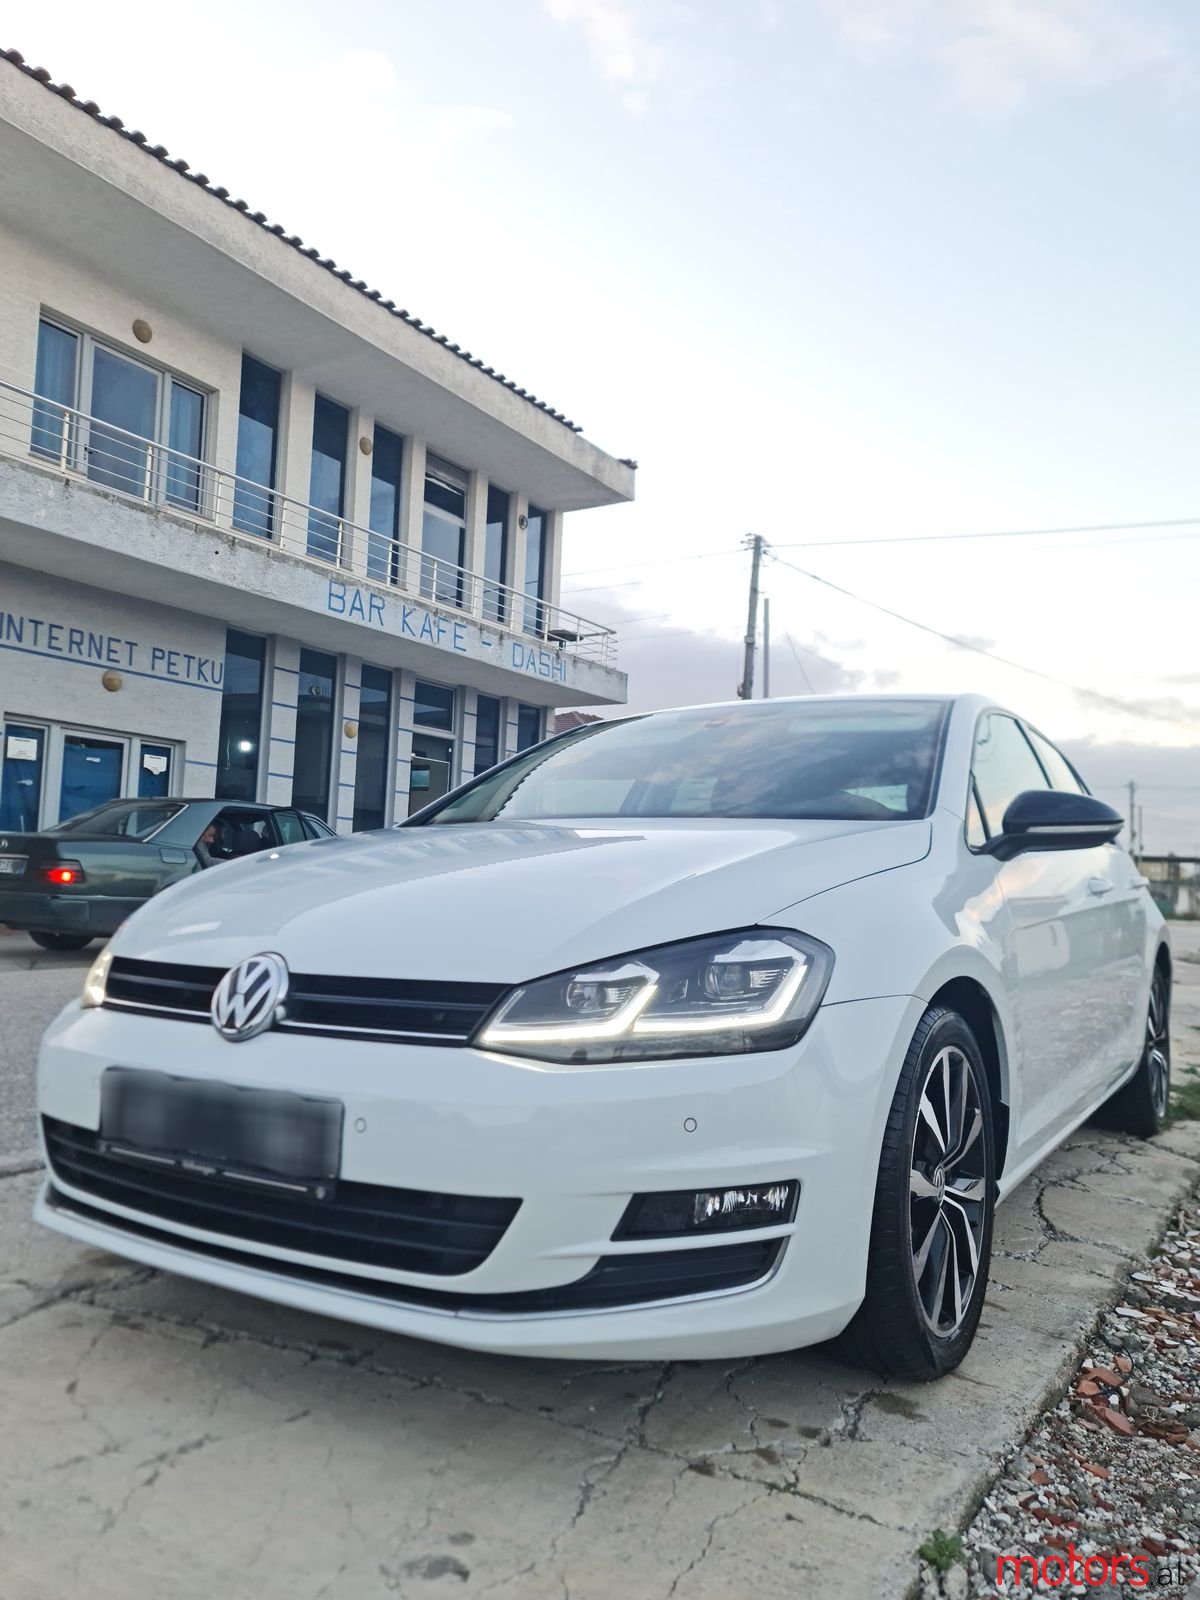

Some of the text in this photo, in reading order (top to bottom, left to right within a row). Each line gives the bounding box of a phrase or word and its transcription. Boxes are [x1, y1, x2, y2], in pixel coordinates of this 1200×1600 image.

[0, 611, 223, 685] INTERNET PETKU
[327, 578, 386, 627] BAR
[402, 604, 467, 652] KAFE
[512, 642, 567, 682] DASHI
